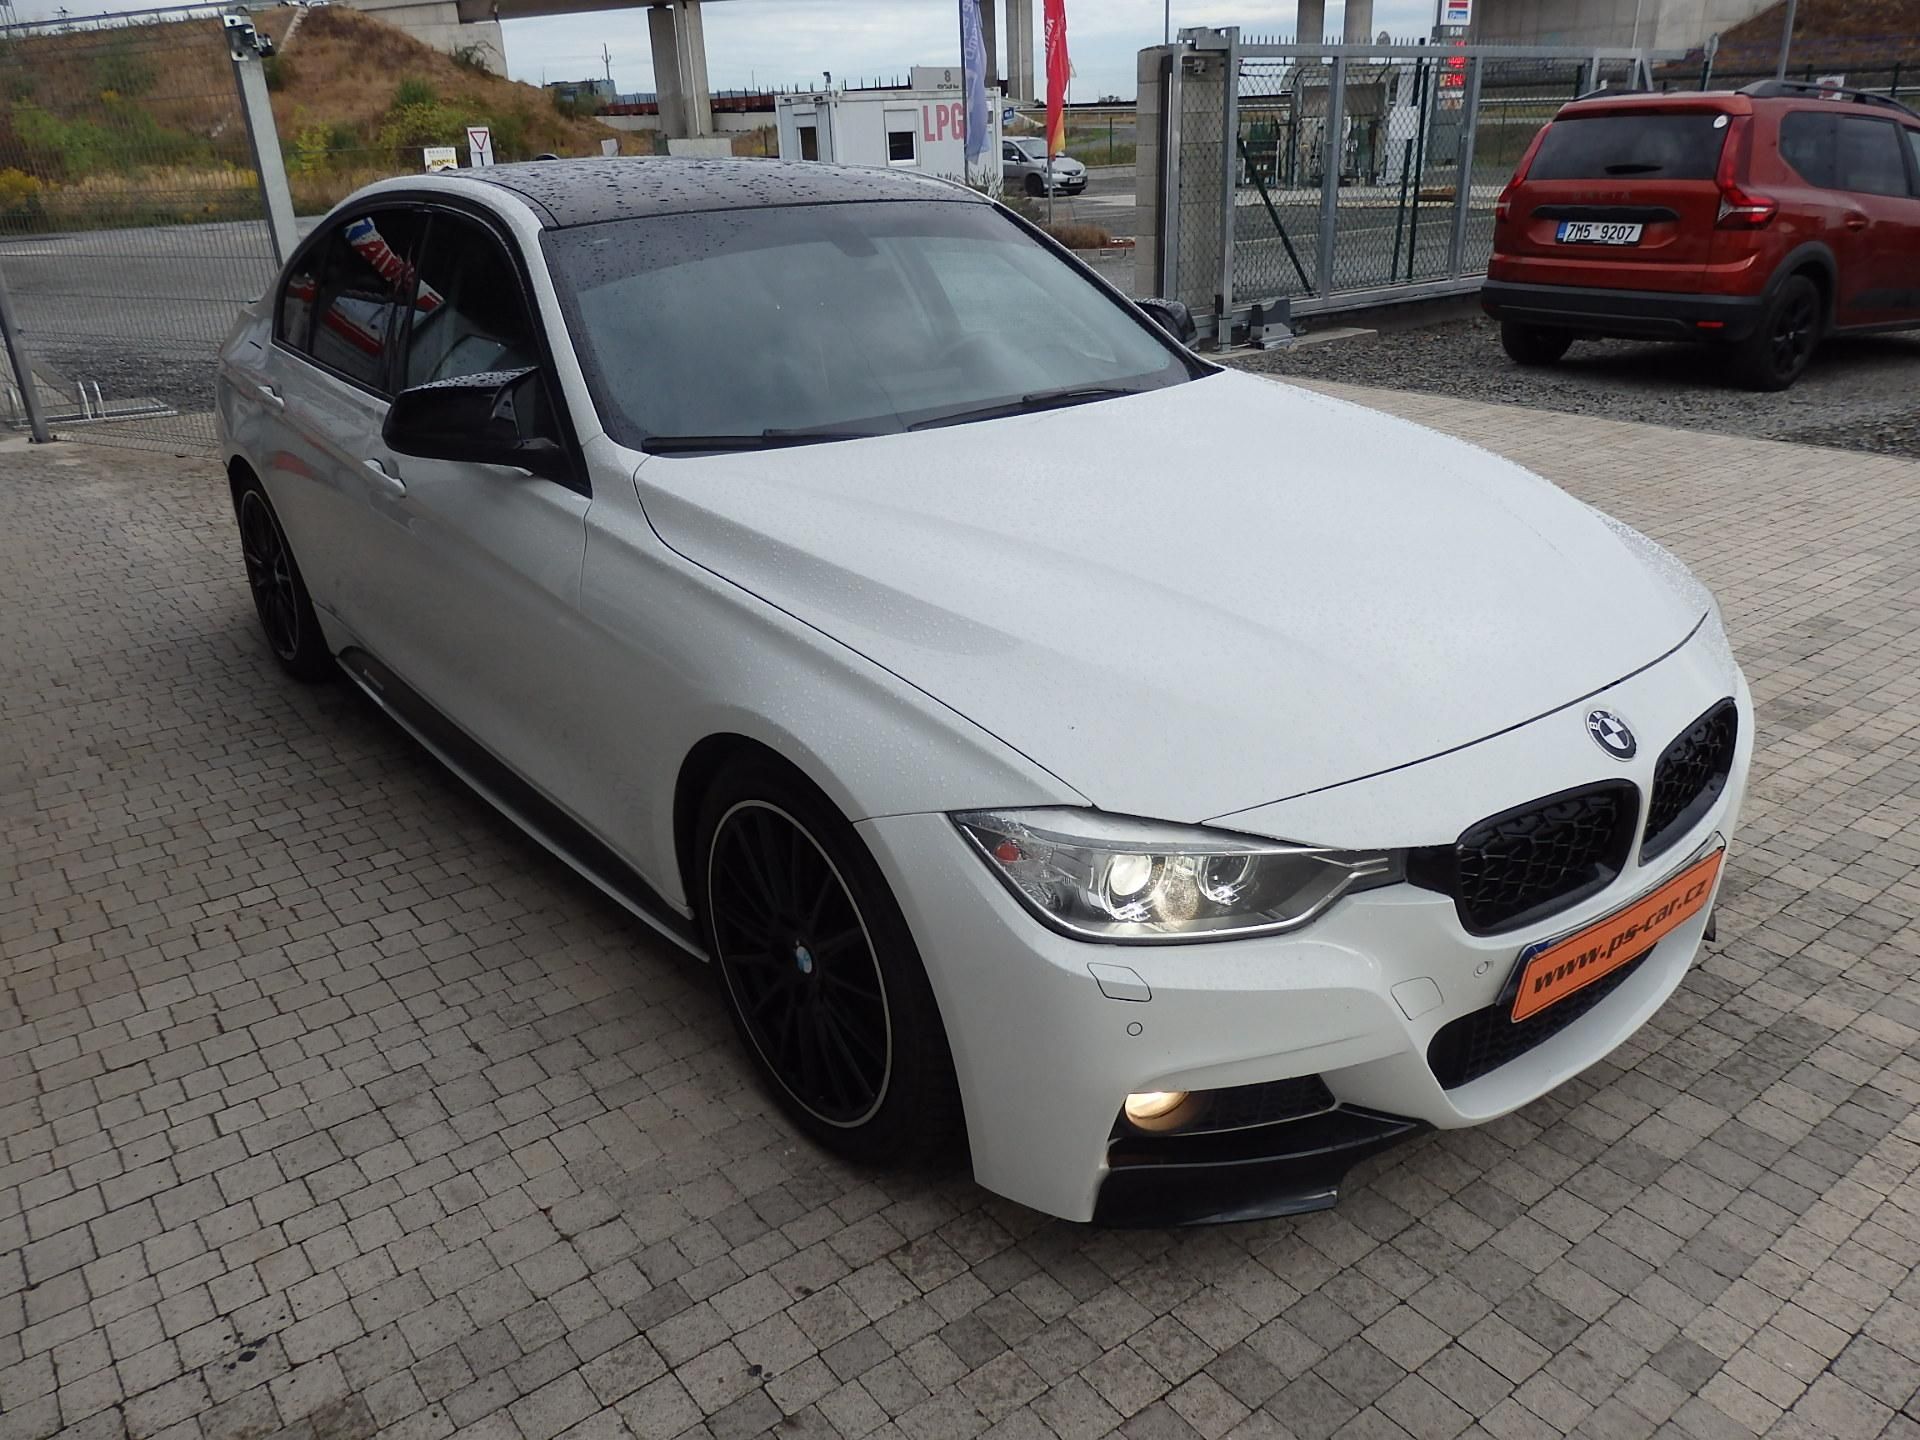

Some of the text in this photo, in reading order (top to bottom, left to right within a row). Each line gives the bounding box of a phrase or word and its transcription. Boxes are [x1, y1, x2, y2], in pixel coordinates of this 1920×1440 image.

[922, 102, 964, 142] LPG
[1600, 225, 1635, 240] 9207
[1533, 879, 1707, 994] www.ps-car.cz
